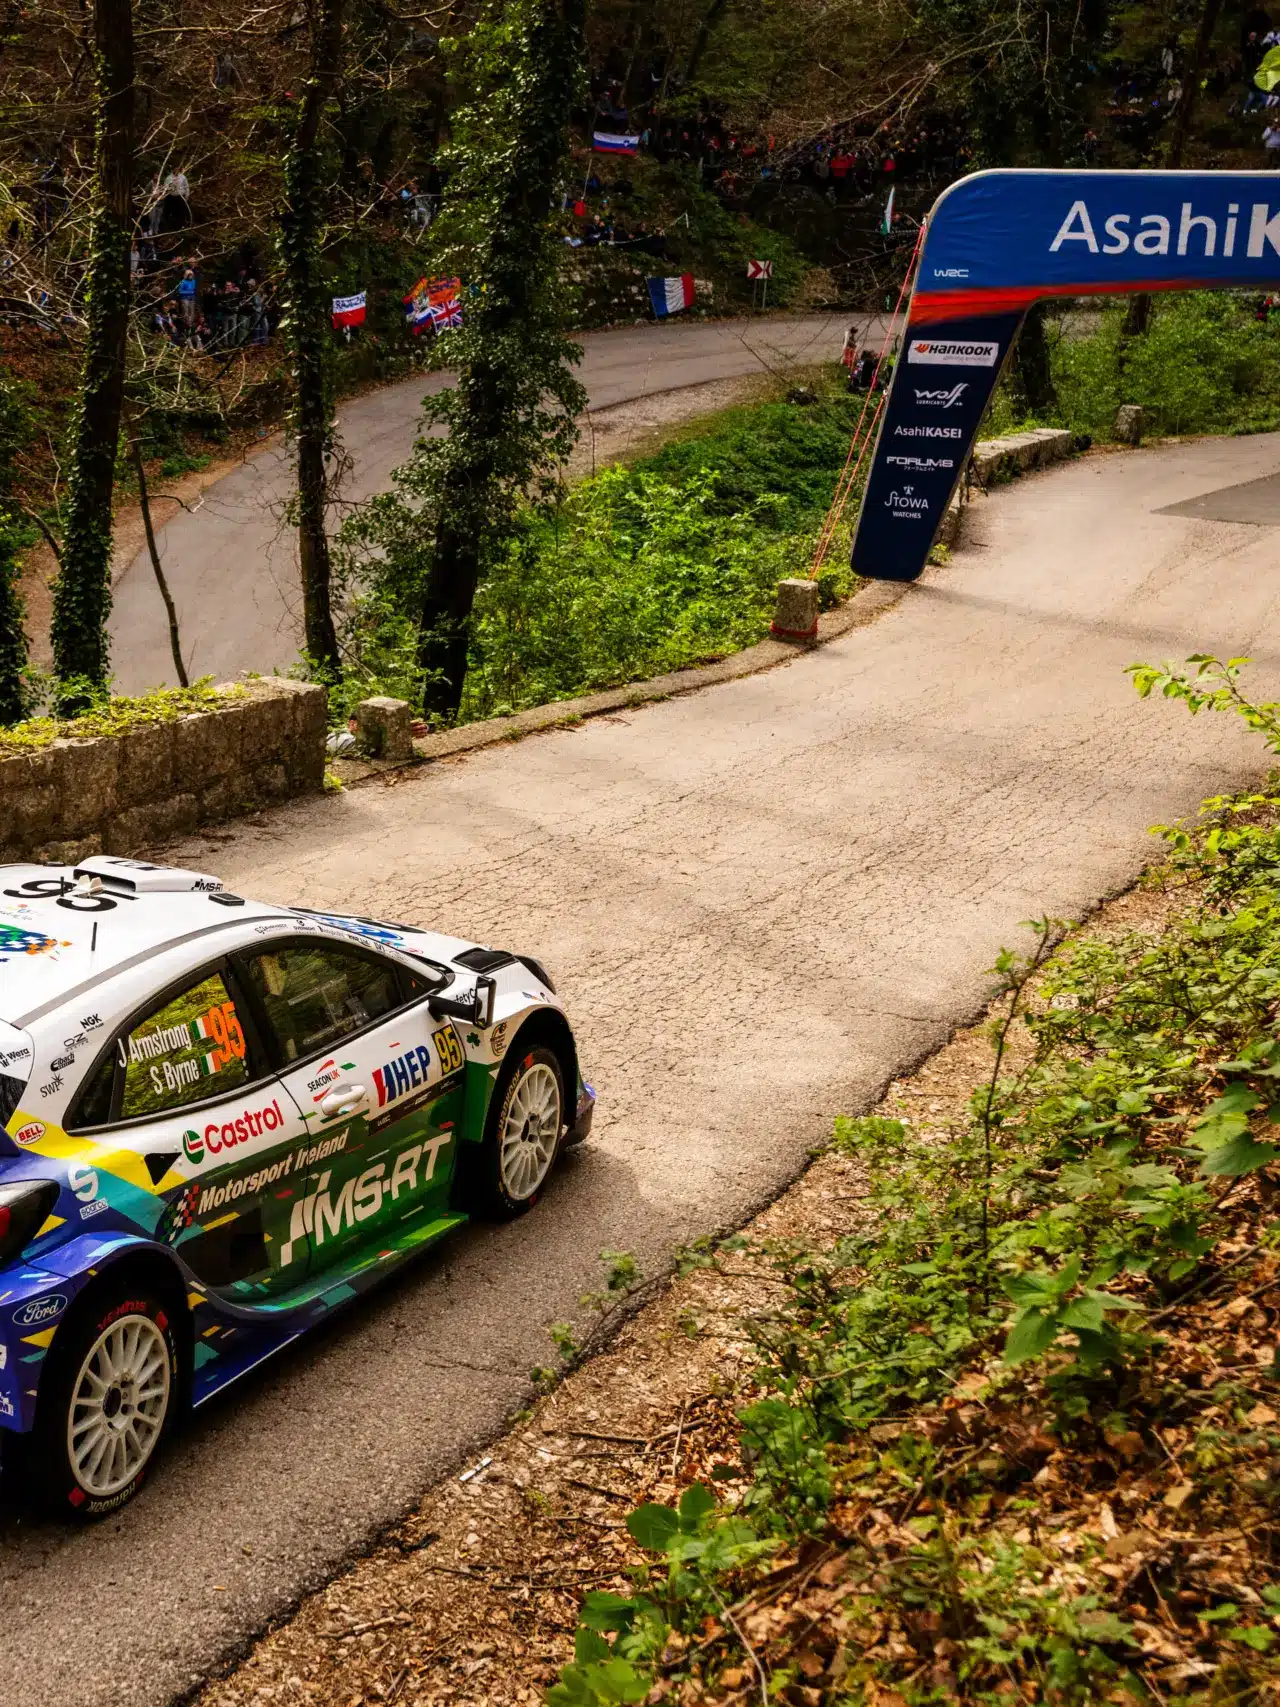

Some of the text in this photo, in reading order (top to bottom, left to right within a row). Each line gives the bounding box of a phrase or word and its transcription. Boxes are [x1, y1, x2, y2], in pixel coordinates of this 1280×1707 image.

[934, 269, 969, 277] WRC
[894, 426, 962, 438] AsahiKASEI
[886, 456, 953, 467] FORUM8
[80, 1013, 102, 1029] NGK
[209, 1001, 246, 1064] 95
[7, 1048, 30, 1060] Wera
[128, 1023, 192, 1067] Armstrong
[439, 1026, 462, 1073] 95
[150, 1057, 200, 1095] S Byrne
[40, 1080, 61, 1098] SWP
[18, 1124, 43, 1141] BELL
[204, 1099, 285, 1154] Castrol
[197, 1127, 350, 1215] Motorsport Ireland
[23, 1299, 59, 1323] Ford
